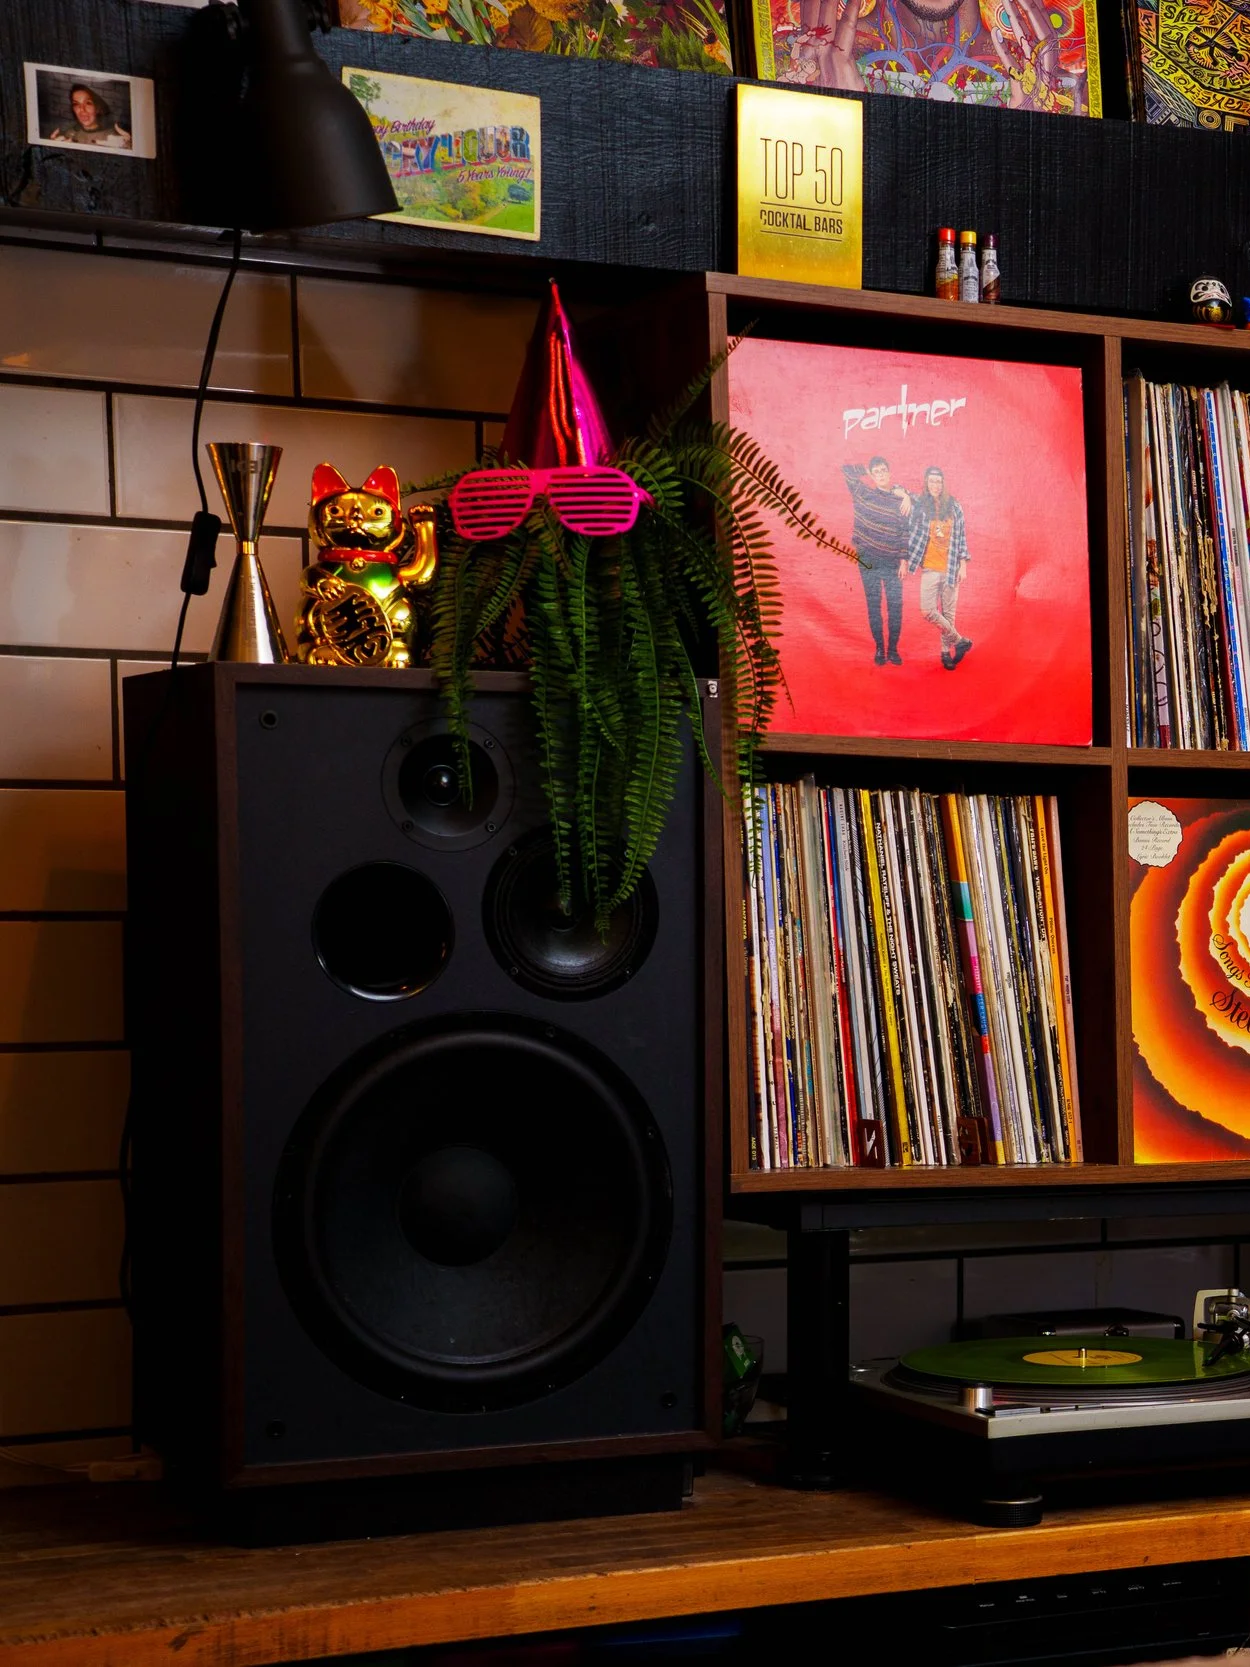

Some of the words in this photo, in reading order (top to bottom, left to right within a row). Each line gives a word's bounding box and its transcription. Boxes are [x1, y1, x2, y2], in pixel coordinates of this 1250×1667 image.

[467, 169, 494, 181] Years
[760, 138, 803, 200] TOP
[815, 145, 842, 206] 50
[814, 216, 842, 234] BARS
[842, 384, 968, 440] partner
